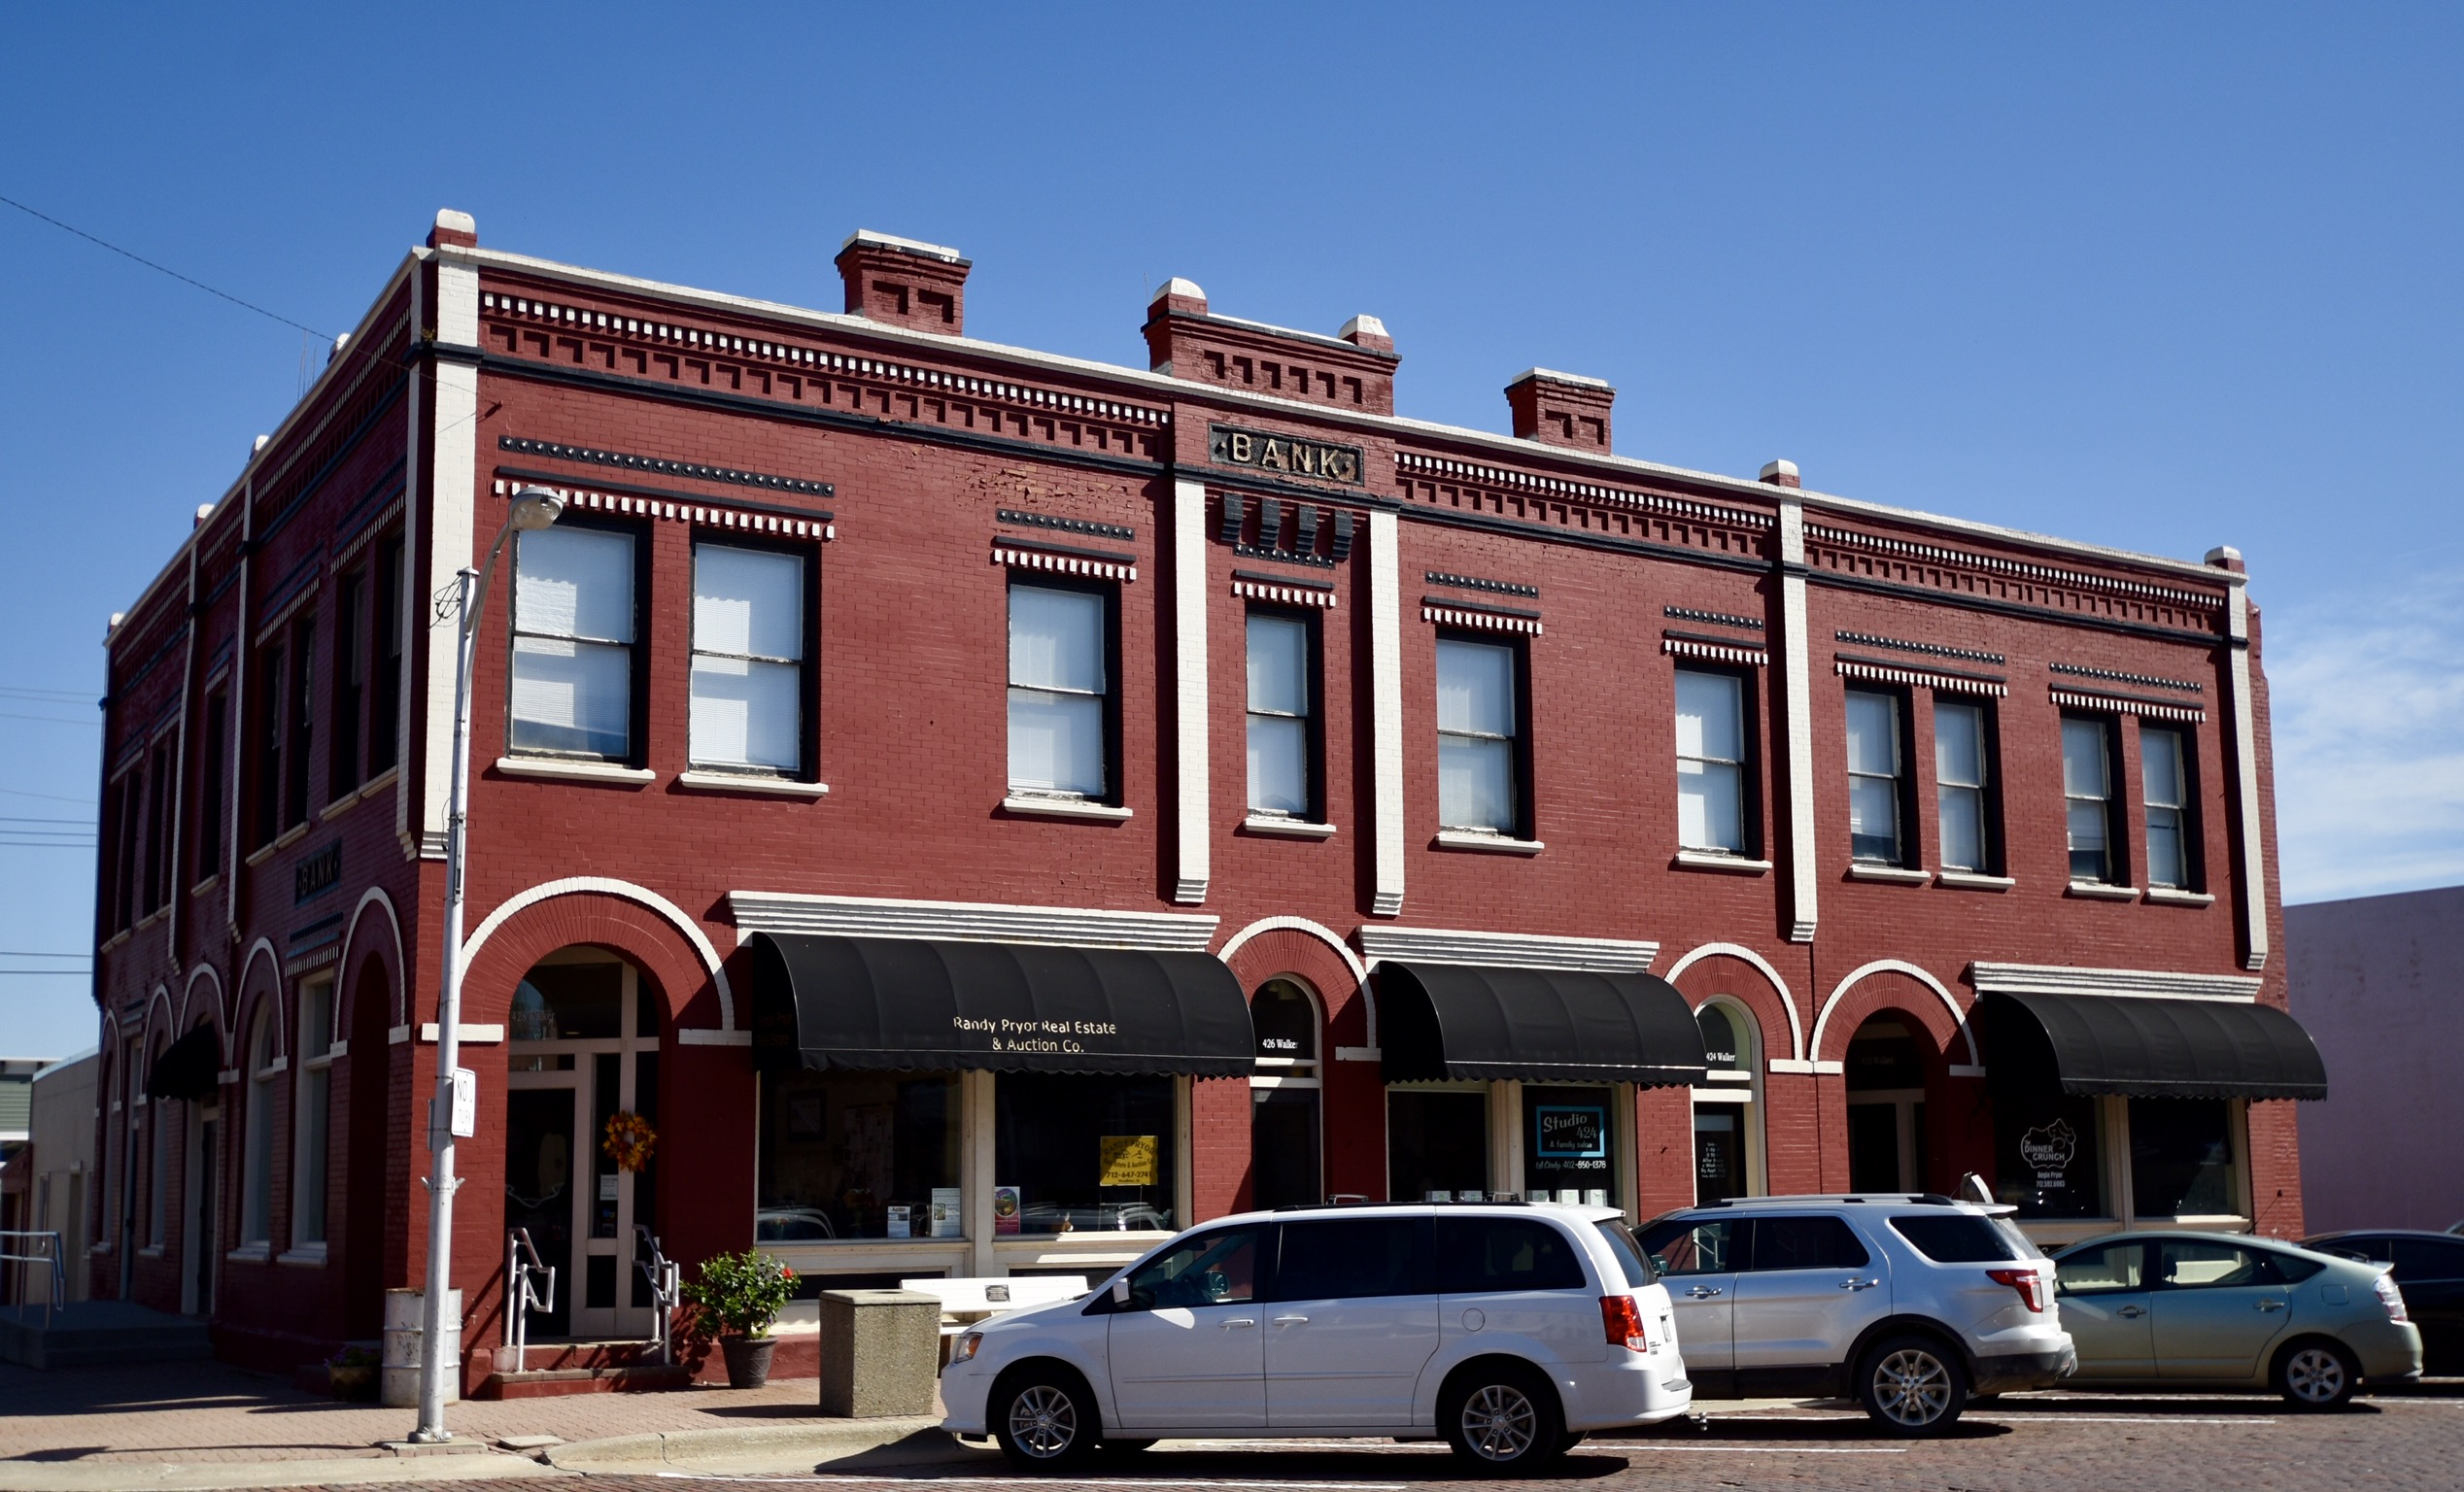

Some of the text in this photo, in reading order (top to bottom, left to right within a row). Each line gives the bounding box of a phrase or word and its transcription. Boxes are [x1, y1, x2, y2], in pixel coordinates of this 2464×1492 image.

[1232, 432, 1340, 479] BANK
[301, 852, 334, 896] BANK
[953, 1016, 1116, 1035] Randy Pryor Real Estate
[992, 1036, 1084, 1053] & Auction Co.
[1262, 1038, 1299, 1049] 426 Walker
[457, 1078, 468, 1102] NO
[1543, 1113, 1588, 1134] Studio
[1576, 1126, 1598, 1139] 424
[1131, 1139, 1155, 1155] PRYOR
[1557, 1140, 1575, 1150] family
[1577, 1140, 1592, 1149] salon
[2024, 1144, 2054, 1153] DINNER
[2032, 1152, 2066, 1162] CRUNCH
